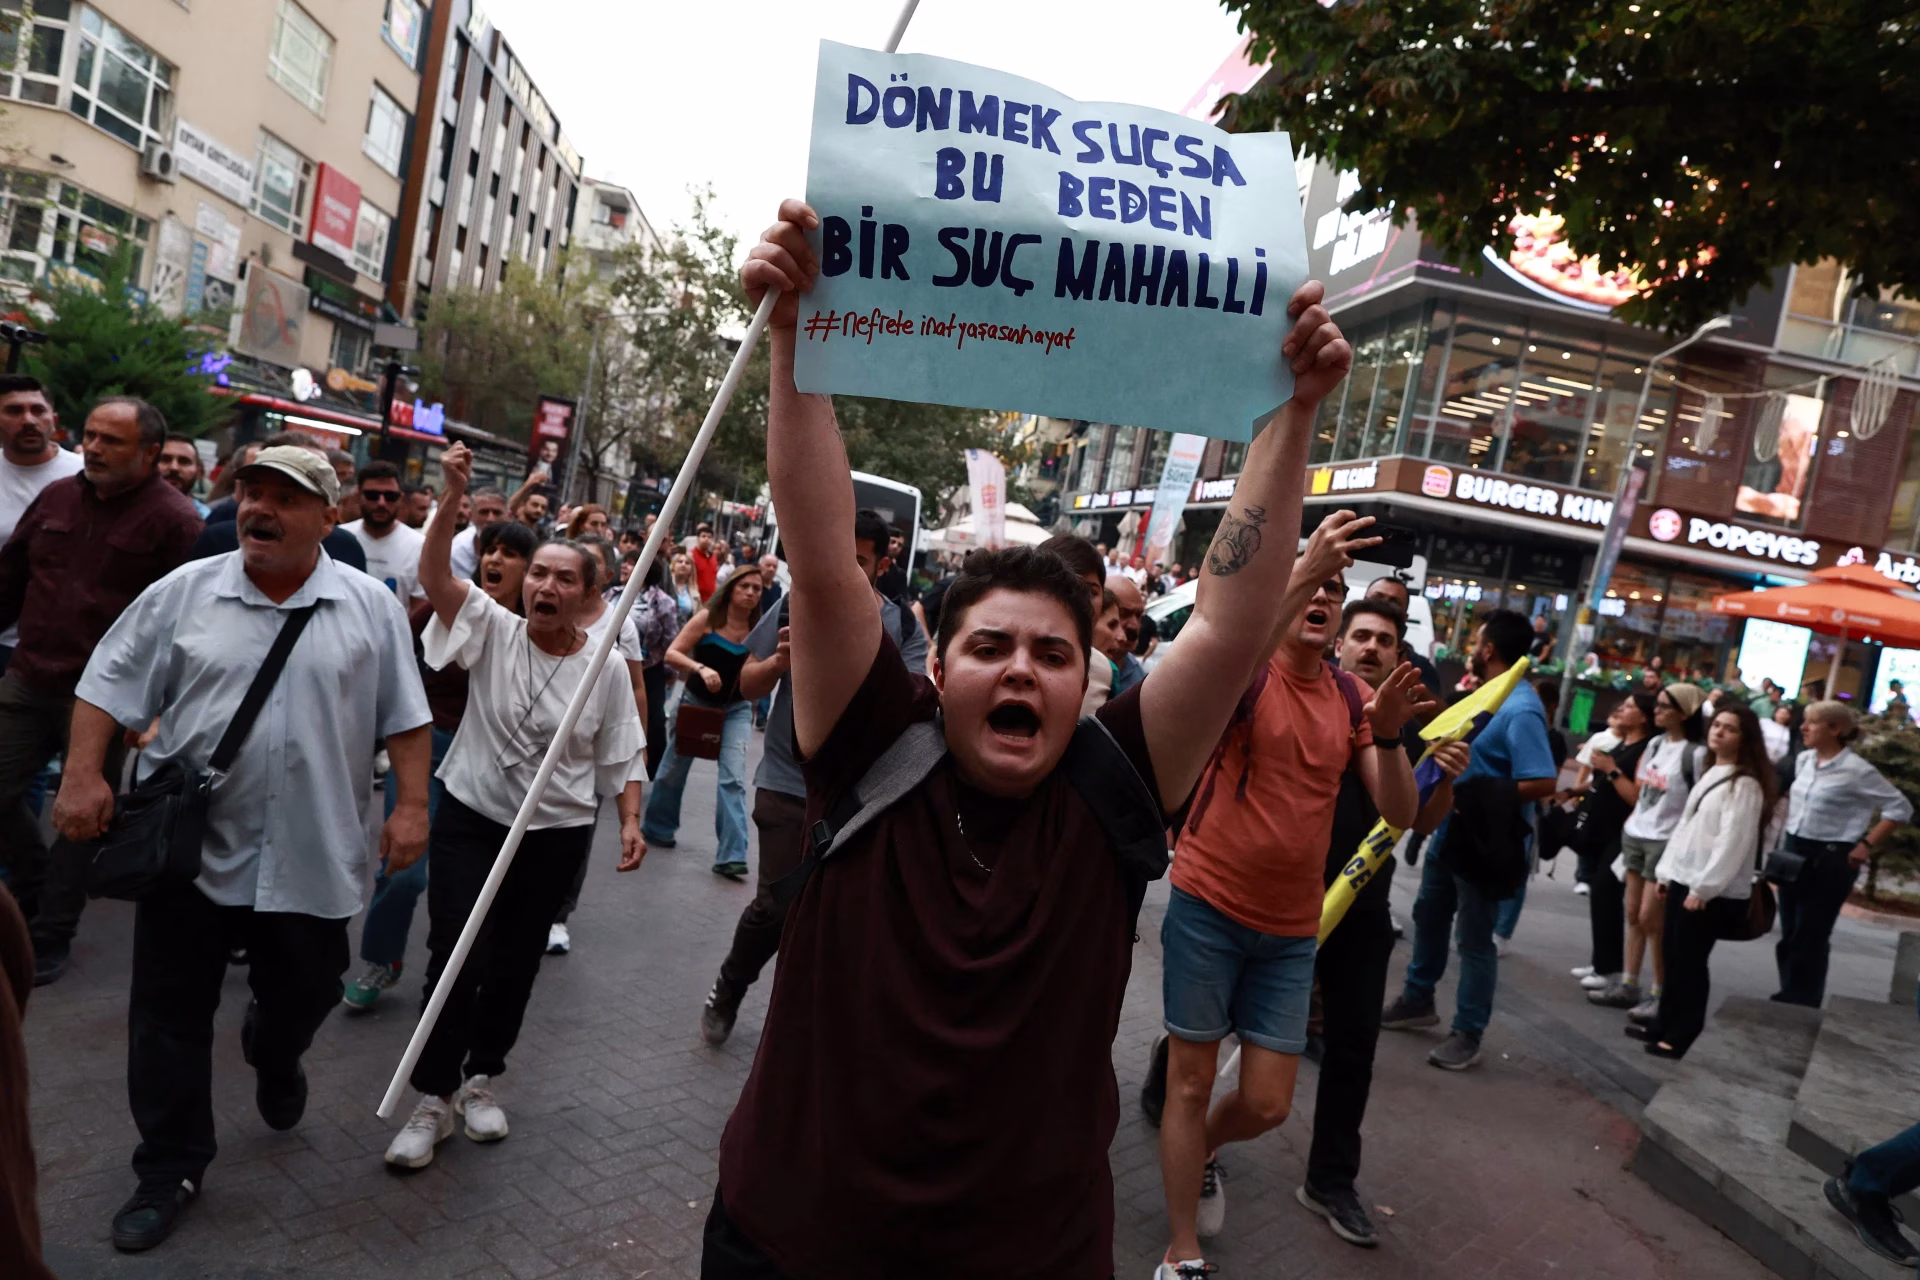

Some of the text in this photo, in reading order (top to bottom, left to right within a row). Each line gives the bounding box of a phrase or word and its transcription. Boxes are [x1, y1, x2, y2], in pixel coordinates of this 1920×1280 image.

[845, 72, 1247, 187] DÖNMEK SUÇSA
[933, 147, 1212, 240] BU BEDEN
[820, 205, 1269, 317] BİR SUÇ MAHALLİ
[1455, 473, 1615, 527] BURGER KIN
[1873, 552, 1920, 592] Arb
